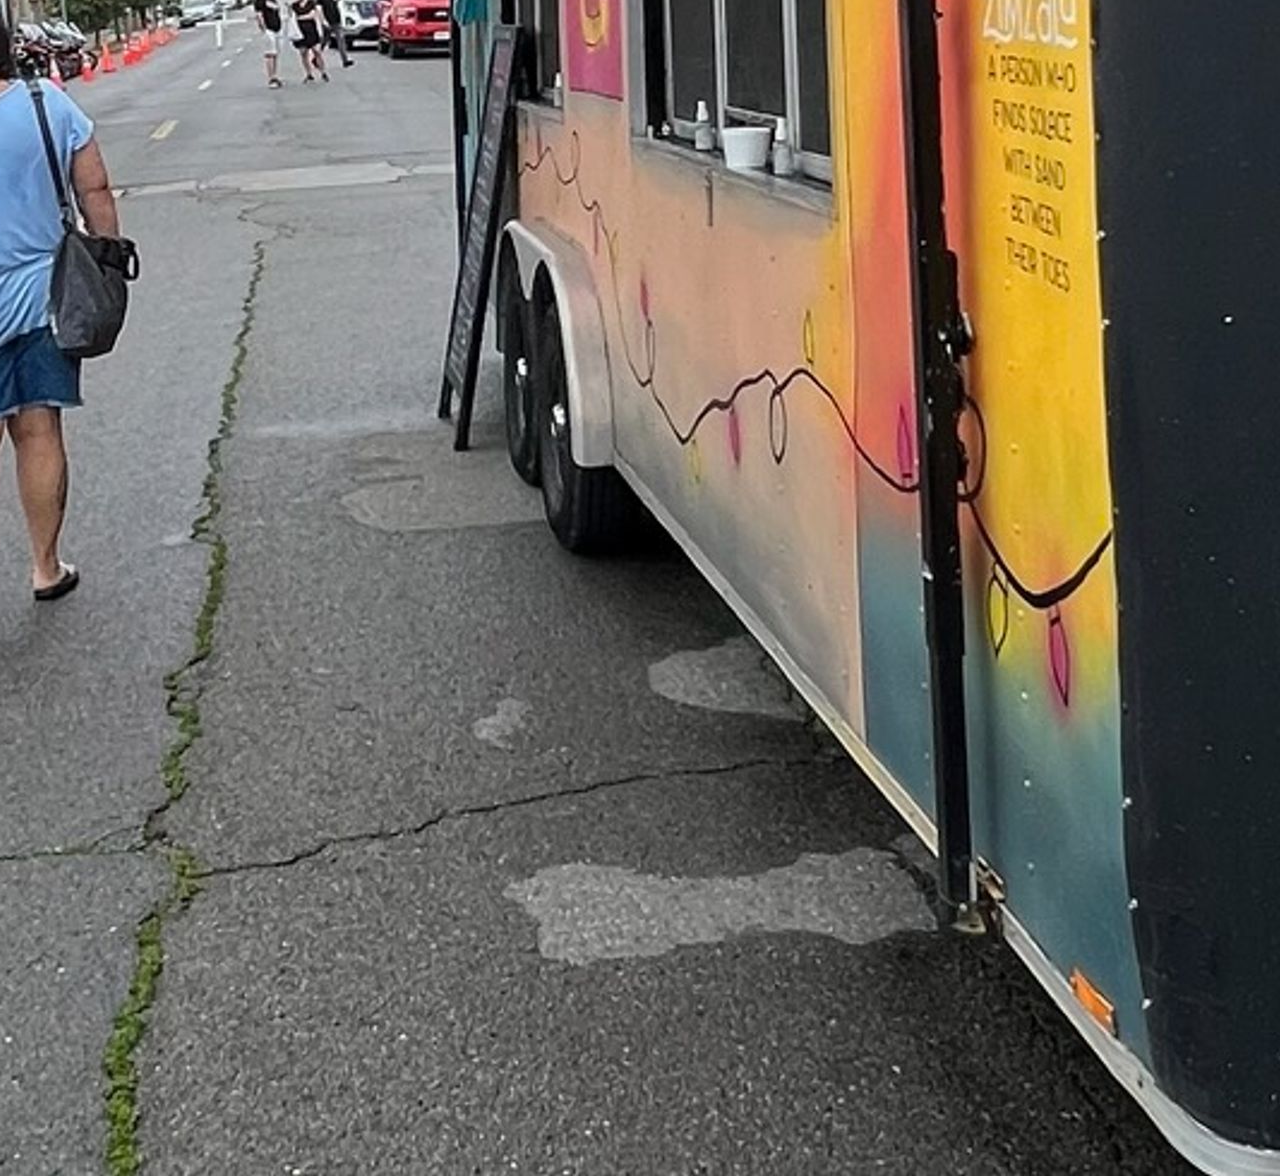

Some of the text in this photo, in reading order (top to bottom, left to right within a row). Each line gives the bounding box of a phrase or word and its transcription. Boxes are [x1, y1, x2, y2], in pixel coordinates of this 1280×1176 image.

[988, 55, 1076, 93] A PERSON WHO
[993, 98, 1073, 144] FINDS SOLACE
[1002, 145, 1067, 191] WITH SAND
[1010, 193, 1061, 240] BETWEEN
[1005, 235, 1070, 292] THEIR TOES
